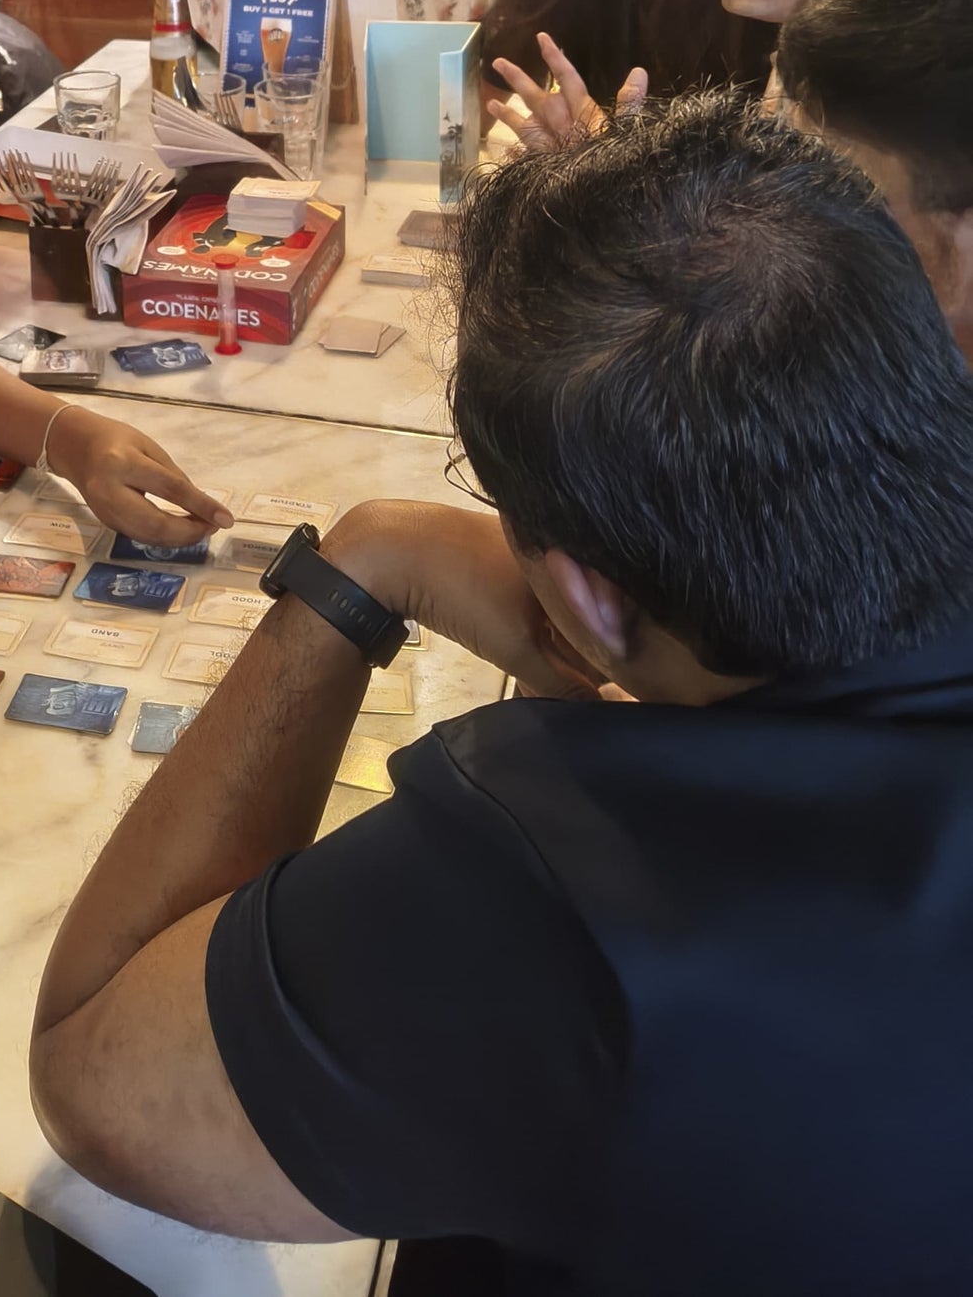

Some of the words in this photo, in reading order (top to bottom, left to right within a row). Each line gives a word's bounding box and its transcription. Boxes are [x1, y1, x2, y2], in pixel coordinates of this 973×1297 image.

[243, 5, 261, 13] BUY
[292, 9, 314, 17] FREE
[142, 260, 288, 282] CODNAMES
[141, 299, 261, 327] CODENAES
[270, 498, 312, 509] STADIUM
[231, 596, 261, 604] HOOD
[91, 628, 120, 638] BAND
